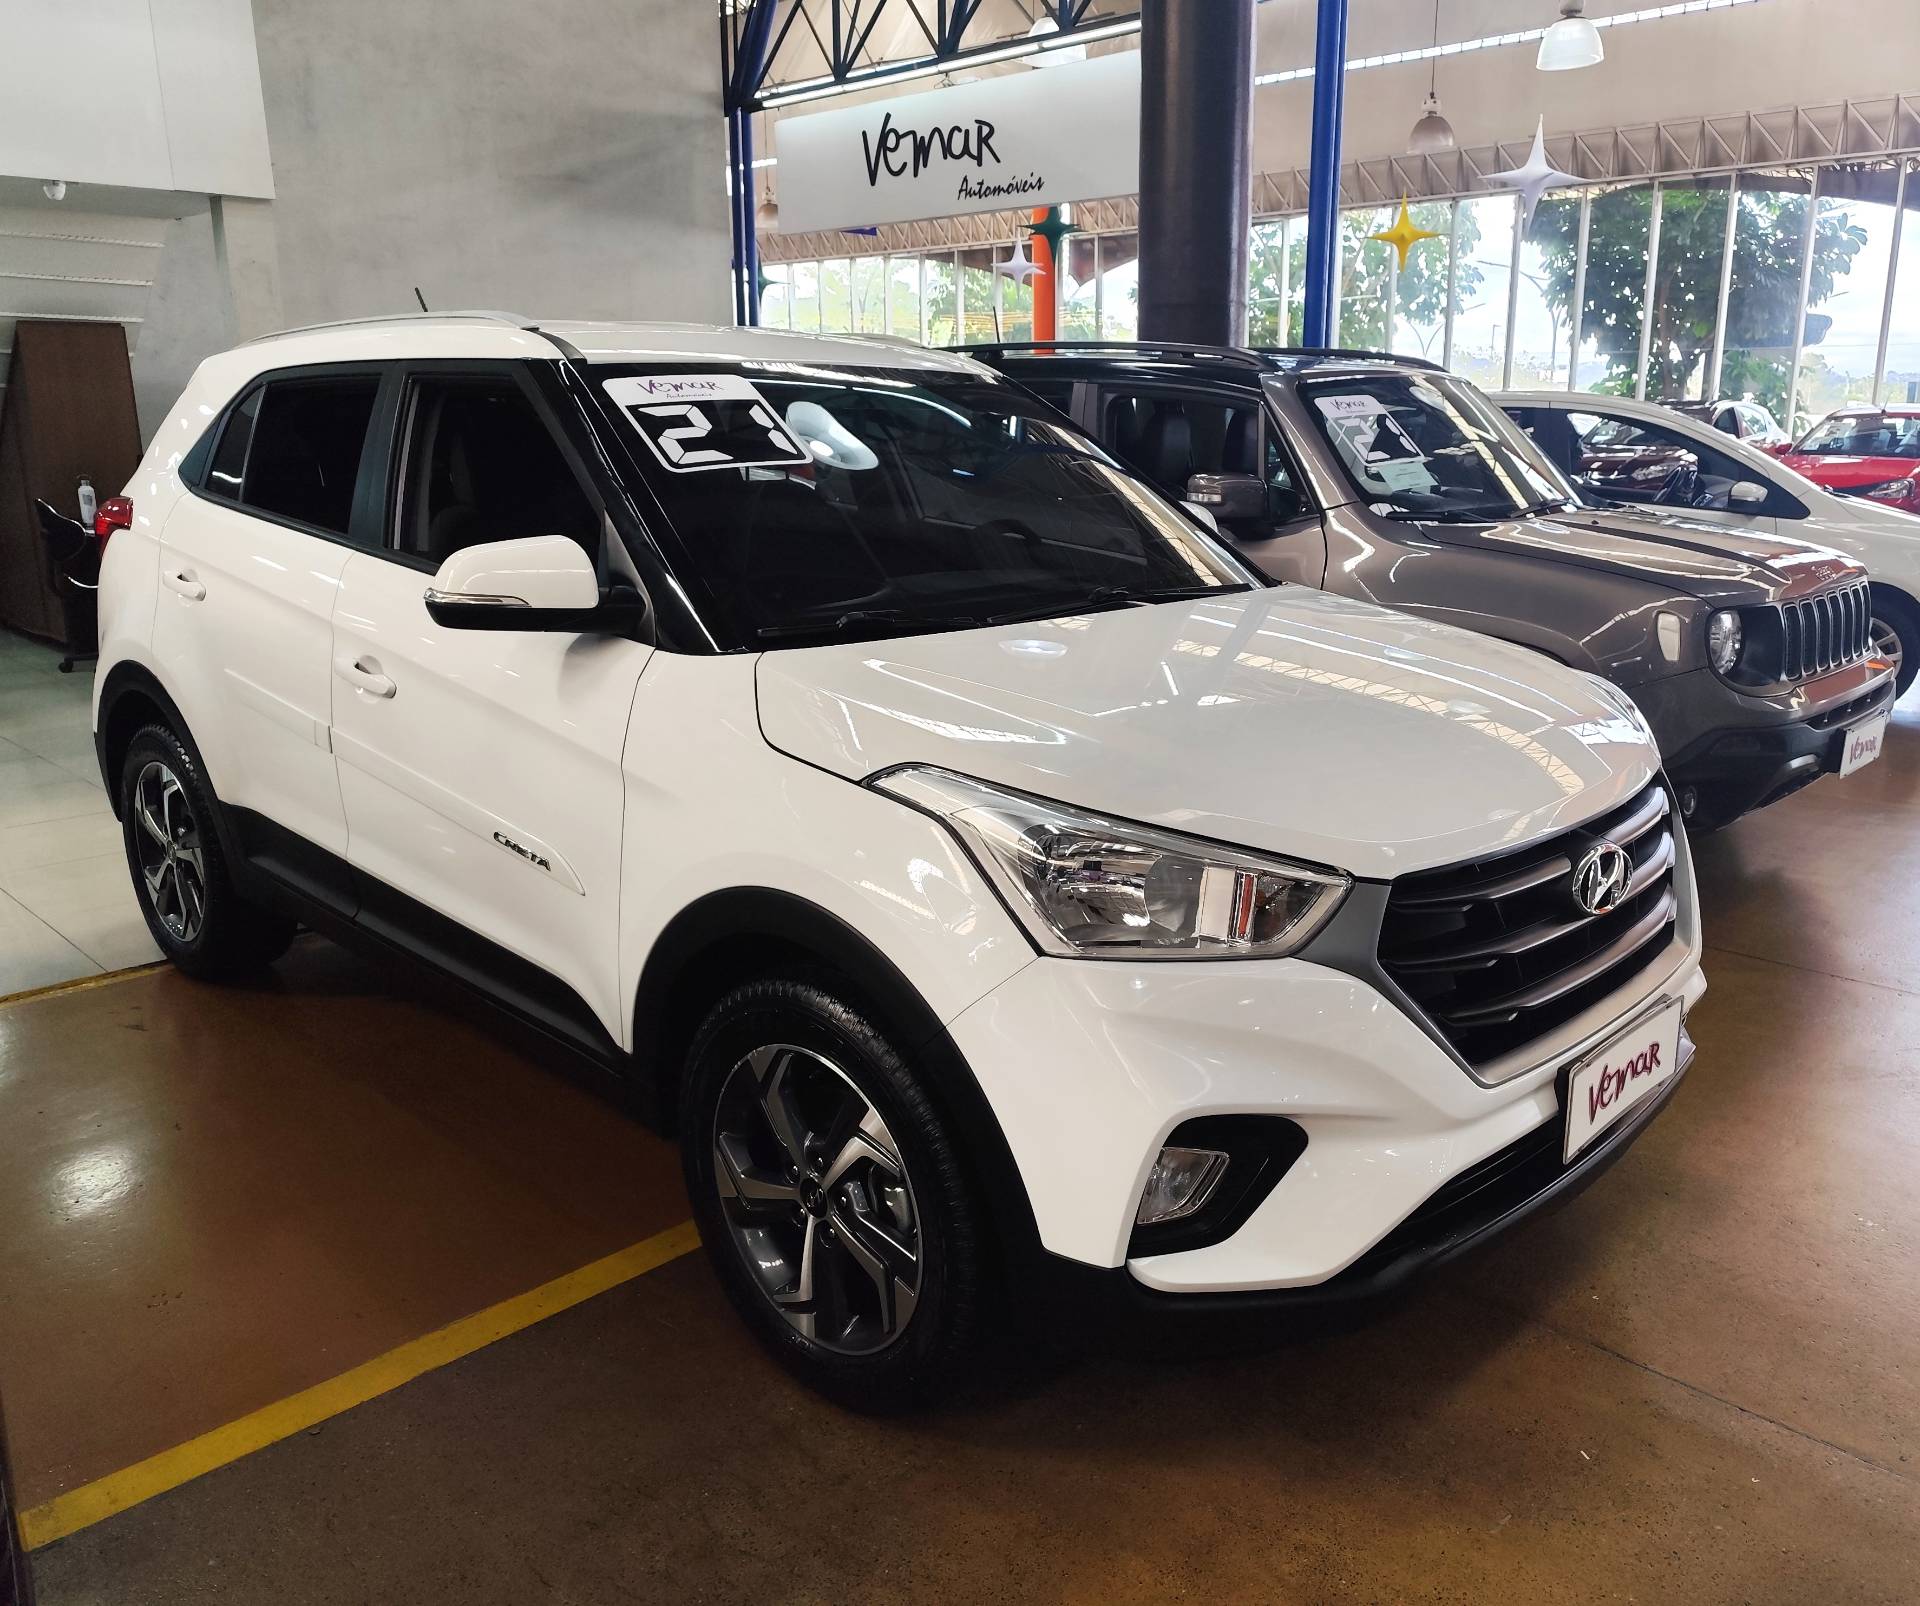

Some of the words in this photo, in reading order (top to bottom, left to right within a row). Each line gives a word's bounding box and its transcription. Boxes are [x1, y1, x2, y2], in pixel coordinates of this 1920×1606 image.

[957, 171, 1046, 201] Automóveis
[637, 404, 798, 465] 21
[493, 831, 552, 872] CRETA
